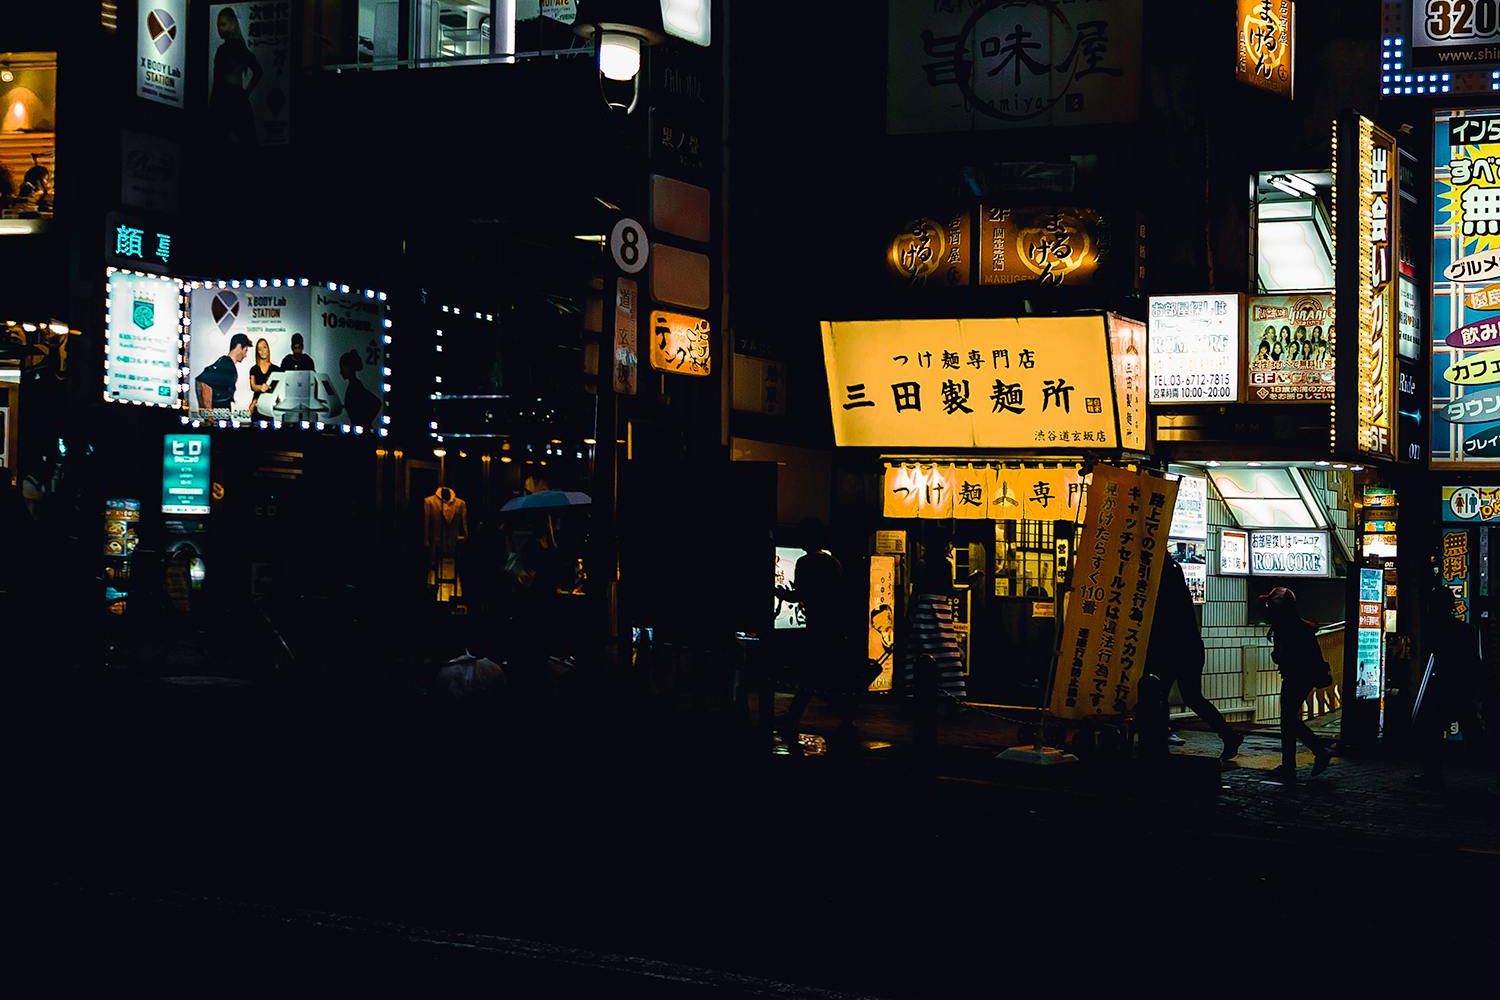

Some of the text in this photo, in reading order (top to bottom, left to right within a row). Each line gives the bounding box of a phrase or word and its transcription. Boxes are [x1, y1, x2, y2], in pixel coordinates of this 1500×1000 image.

[145, 71, 176, 89] STATION
[618, 227, 641, 263] 8
[273, 296, 287, 307] Lab
[252, 307, 281, 319] STATION
[893, 349, 1035, 370] つけ麺専門店
[1253, 373, 1276, 383] 6F
[842, 379, 1075, 414] 三田製麺所
[1034, 429, 1107, 443] 渋谷道玄坂店
[1286, 552, 1321, 572] CORE
